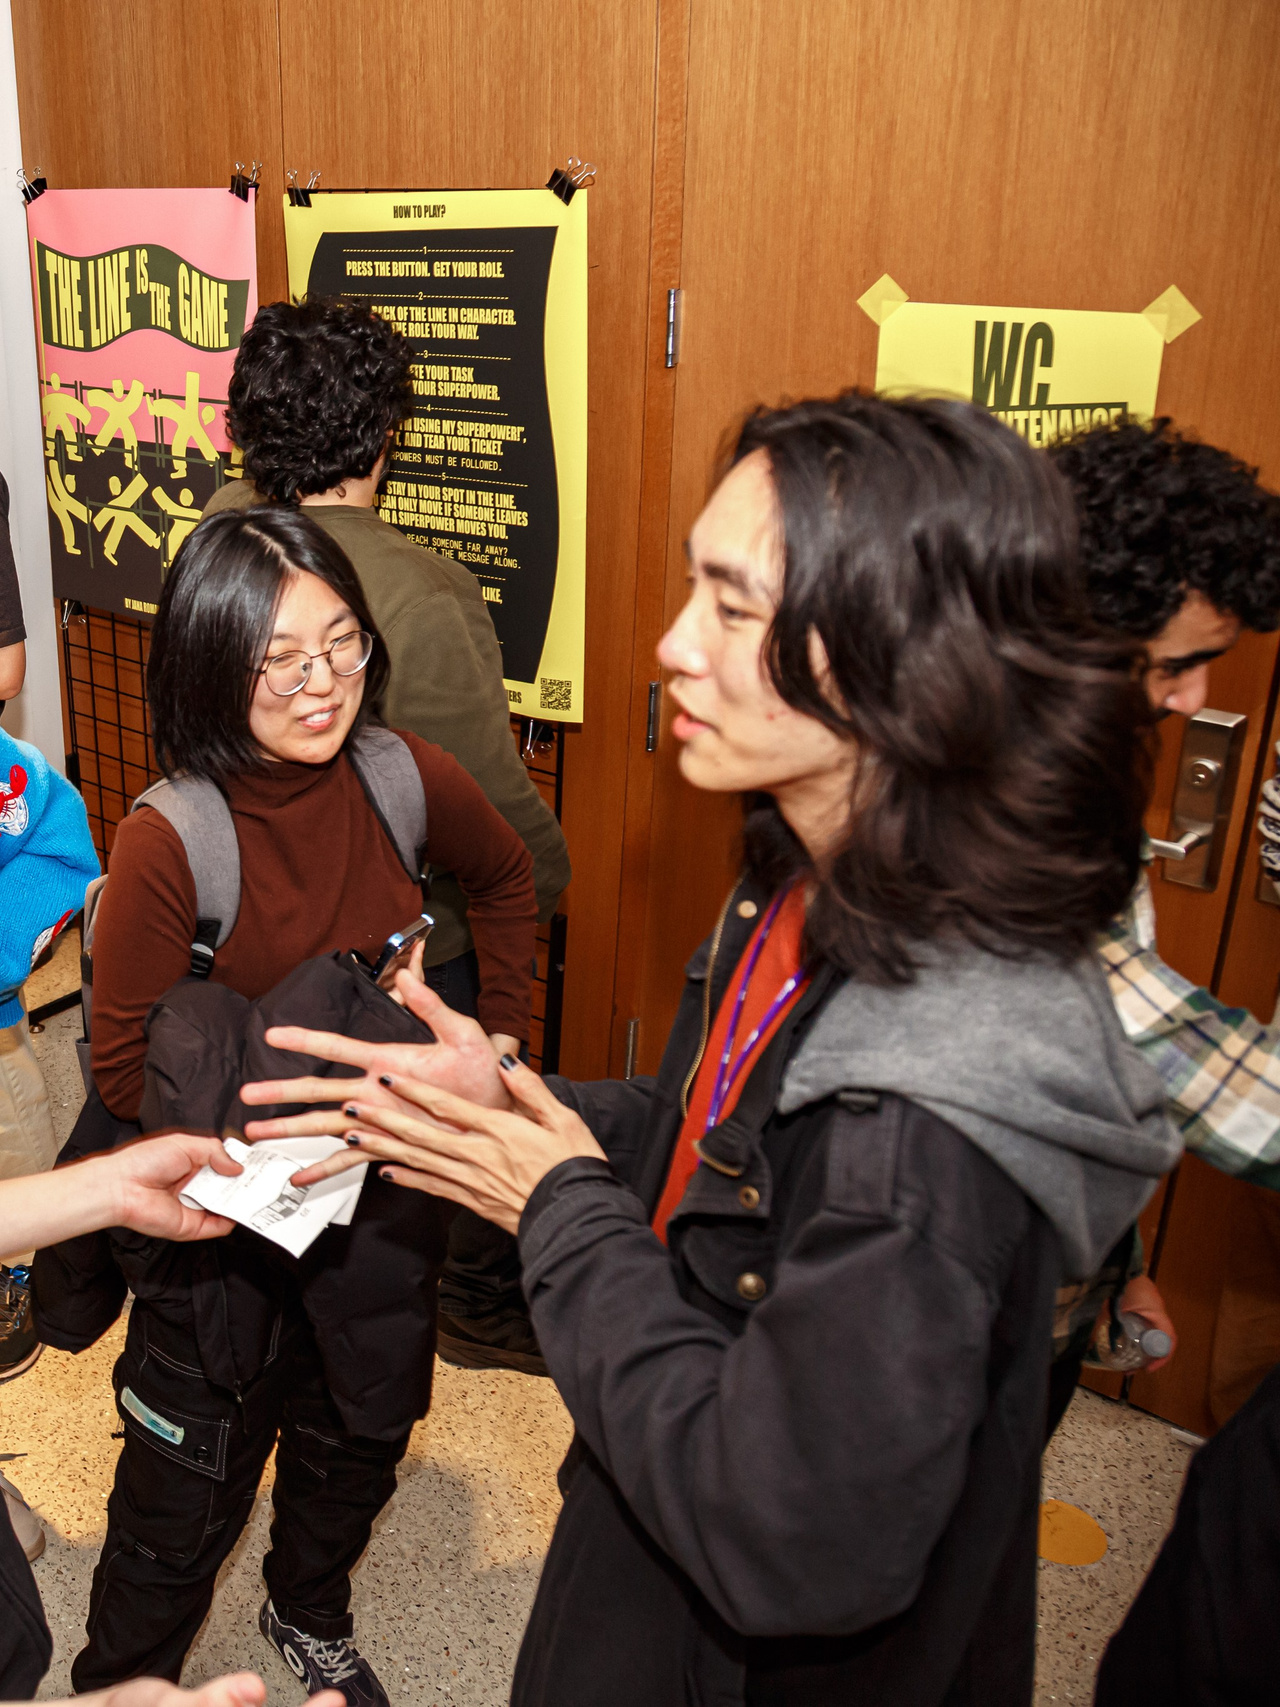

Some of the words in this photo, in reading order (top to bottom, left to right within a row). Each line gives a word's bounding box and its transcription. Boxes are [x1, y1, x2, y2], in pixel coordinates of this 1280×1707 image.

[393, 205, 411, 219] HOW
[413, 205, 422, 218] TO
[424, 204, 446, 218] PLAY?
[346, 261, 373, 276] PRESS
[374, 261, 391, 277] THE
[392, 261, 430, 277] BUTTON.
[433, 261, 451, 277] GET
[452, 261, 477, 278] YOUR
[479, 262, 504, 278] ROLE.
[45, 249, 84, 348] THE
[87, 250, 132, 348] LINE
[135, 248, 149, 294] IS
[149, 281, 171, 330] THE
[178, 262, 230, 349] GAME
[397, 307, 409, 321] OF
[410, 307, 427, 322] THE
[428, 307, 447, 323] LINE
[448, 308, 459, 323] IN
[460, 308, 516, 325] CHARACTER.
[409, 323, 430, 338] ROLE
[431, 323, 456, 339] YOUR
[458, 324, 479, 340] WAY.
[425, 365, 450, 381] YOUR
[451, 366, 474, 382] TASK
[973, 320, 1055, 407] WC
[412, 380, 436, 396] YOUR
[438, 381, 500, 400] SUPERPOWER.
[413, 417, 441, 434] USING
[442, 419, 456, 435] MY
[404, 433, 422, 448] AND
[423, 434, 446, 450] TEAR
[446, 436, 470, 452] YOUR
[471, 438, 503, 456] TICKET.
[425, 454, 444, 466] MUST
[447, 456, 457, 467] BE
[461, 458, 502, 472] FOLLOWED.
[386, 480, 406, 496] STAY
[407, 483, 417, 498] IN
[418, 484, 441, 500] YOUR
[442, 486, 465, 503] SPOT
[466, 489, 476, 504] IN
[477, 491, 494, 507] THE
[495, 493, 517, 510] LINE.
[380, 494, 397, 509] CAN
[398, 496, 418, 512] ONLY
[419, 499, 443, 516] MOVE
[444, 502, 453, 517] IF
[453, 503, 495, 522] SOMEONE
[496, 507, 528, 527] LEAVES
[379, 508, 391, 523] OR
[391, 510, 398, 525] A
[399, 511, 455, 533] SUPERPOWER
[456, 519, 487, 537] MOVES
[487, 524, 509, 540] YOU.
[432, 537, 463, 550] SOMEONE
[467, 542, 481, 553] FAR
[485, 545, 509, 557] AWAY?
[441, 548, 455, 560] THE
[458, 551, 490, 565] MESSAGE
[493, 556, 522, 570] ALONG.
[482, 586, 503, 605] LIKE,
